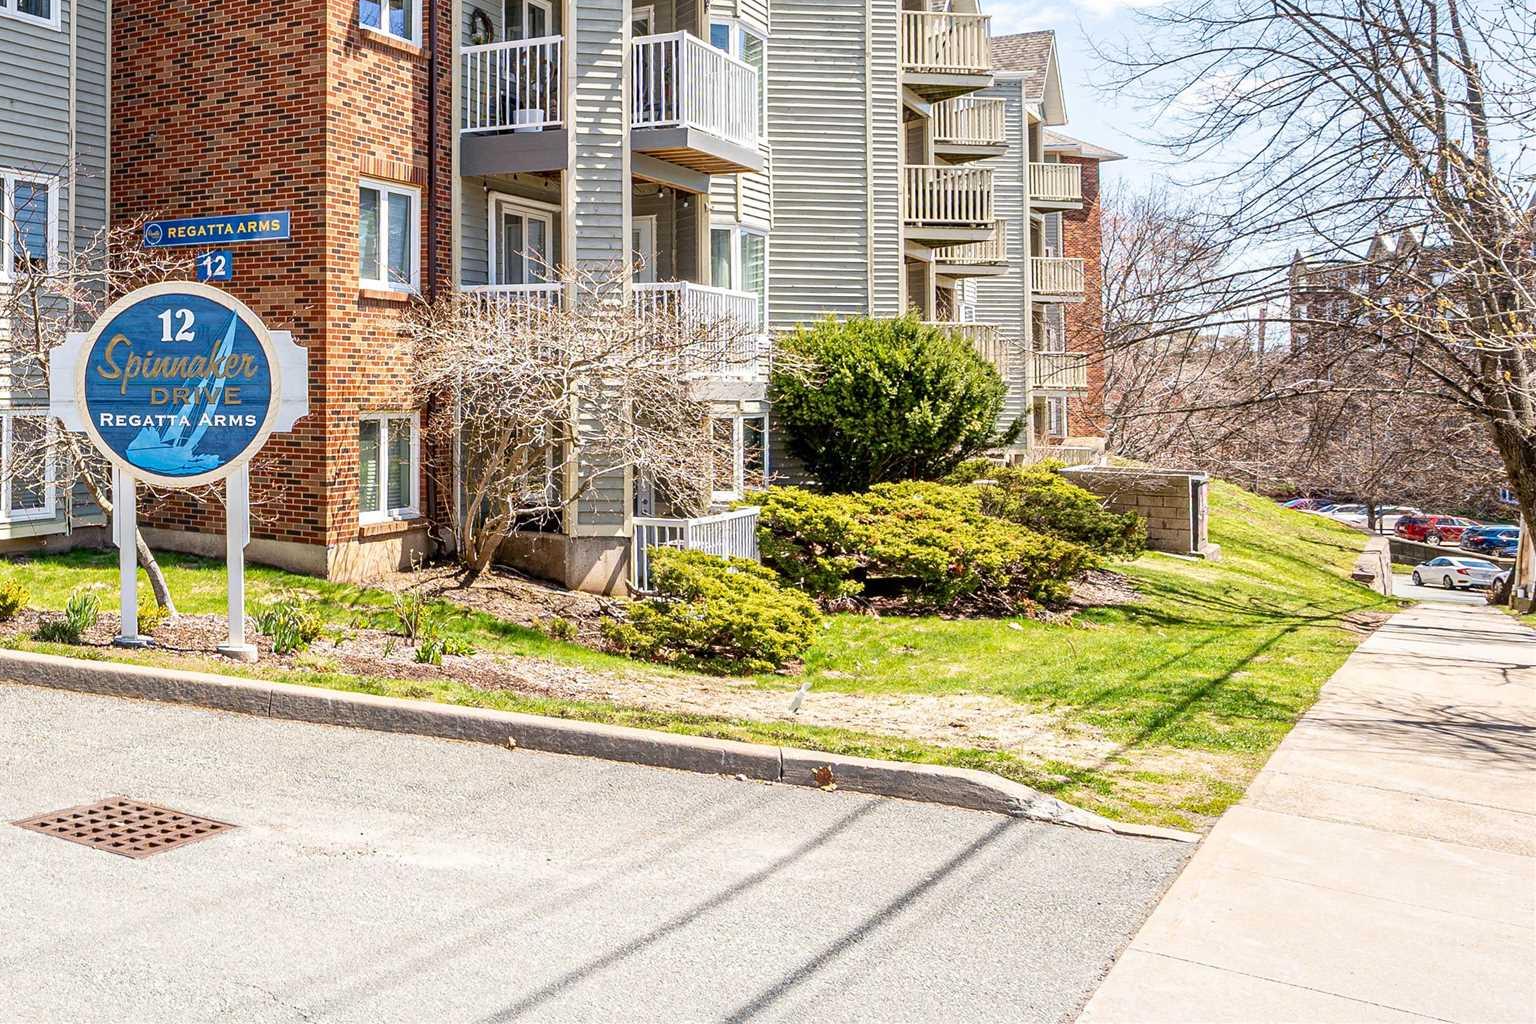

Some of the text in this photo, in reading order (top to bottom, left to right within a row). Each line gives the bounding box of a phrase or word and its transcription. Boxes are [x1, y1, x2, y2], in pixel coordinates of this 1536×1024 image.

[168, 224, 233, 238] REGATTA
[236, 219, 280, 233] ARMS
[203, 255, 226, 276] 12
[157, 308, 196, 342] 12
[96, 332, 259, 395] Spinnaker
[150, 387, 242, 406] DRIVE
[100, 413, 257, 427] REGATTA ARMS
